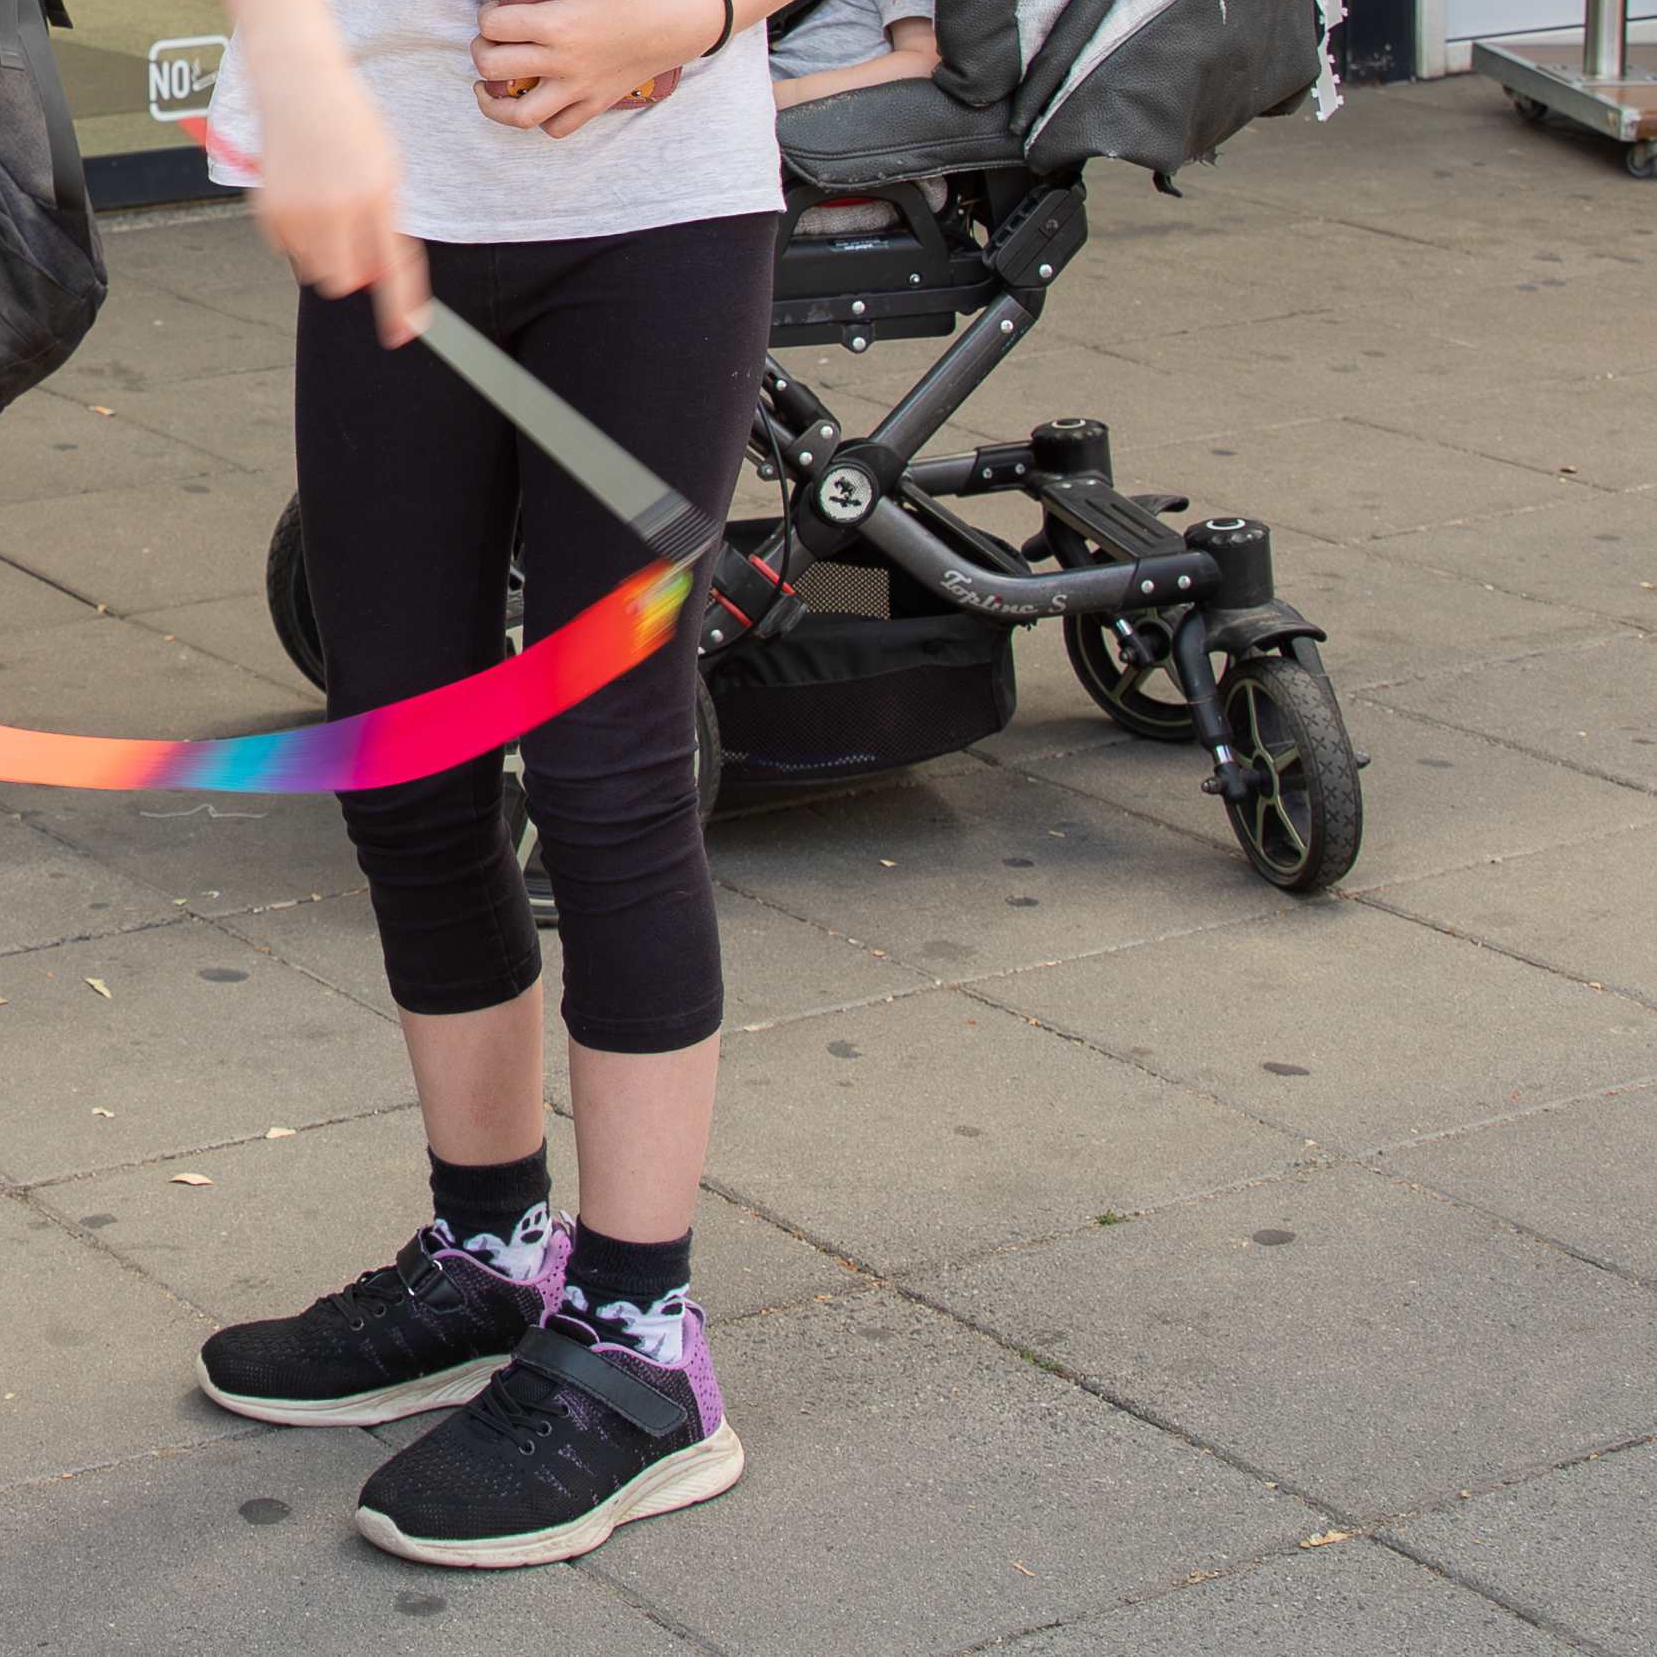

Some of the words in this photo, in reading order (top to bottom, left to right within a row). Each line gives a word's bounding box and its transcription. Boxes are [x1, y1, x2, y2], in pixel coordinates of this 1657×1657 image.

[149, 58, 190, 100] NO
[940, 569, 1038, 614] Topline
[1048, 593, 1067, 614] S
